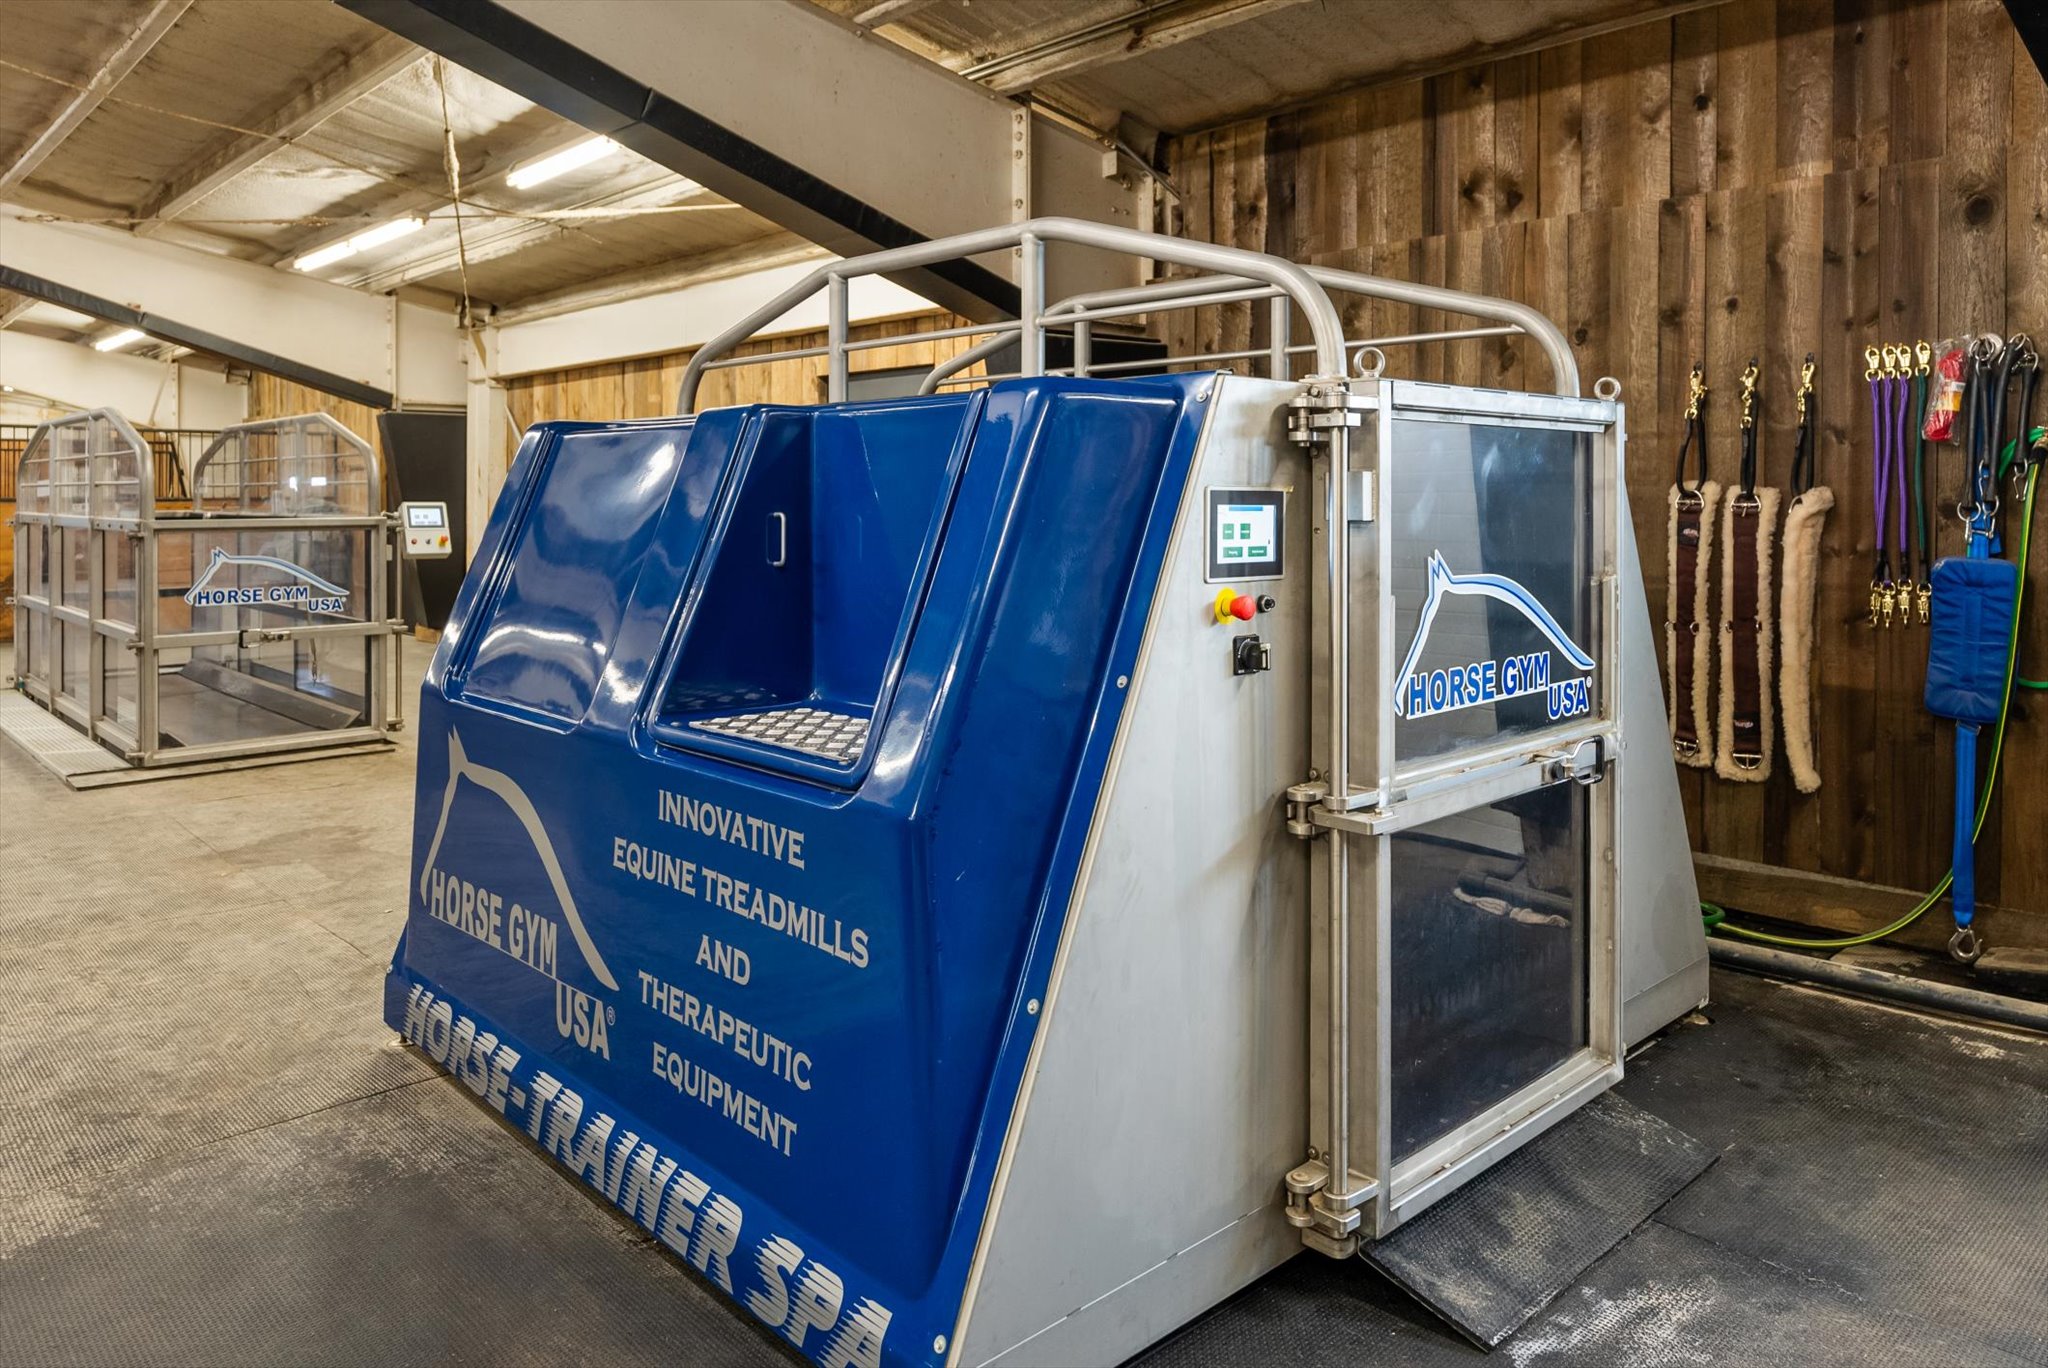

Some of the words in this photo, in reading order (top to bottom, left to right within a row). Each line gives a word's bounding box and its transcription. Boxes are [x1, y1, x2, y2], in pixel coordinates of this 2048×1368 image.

[197, 588, 263, 605] HORSE
[269, 587, 308, 601] GYM
[1409, 661, 1496, 717] HORSE
[1502, 653, 1549, 696] GYM
[658, 789, 805, 871] INNOVATIVE
[430, 868, 503, 950] HORSE
[508, 903, 558, 979] GYM
[612, 836, 697, 898] EQUINE
[701, 866, 869, 969] TREADMILLS
[695, 934, 751, 986] AND
[638, 968, 812, 1091] THERAPEUTIC
[652, 1041, 798, 1157] EQUIPMENT
[402, 982, 743, 1295] HORSE-TRAINER
[743, 1233, 894, 1368] SPA
